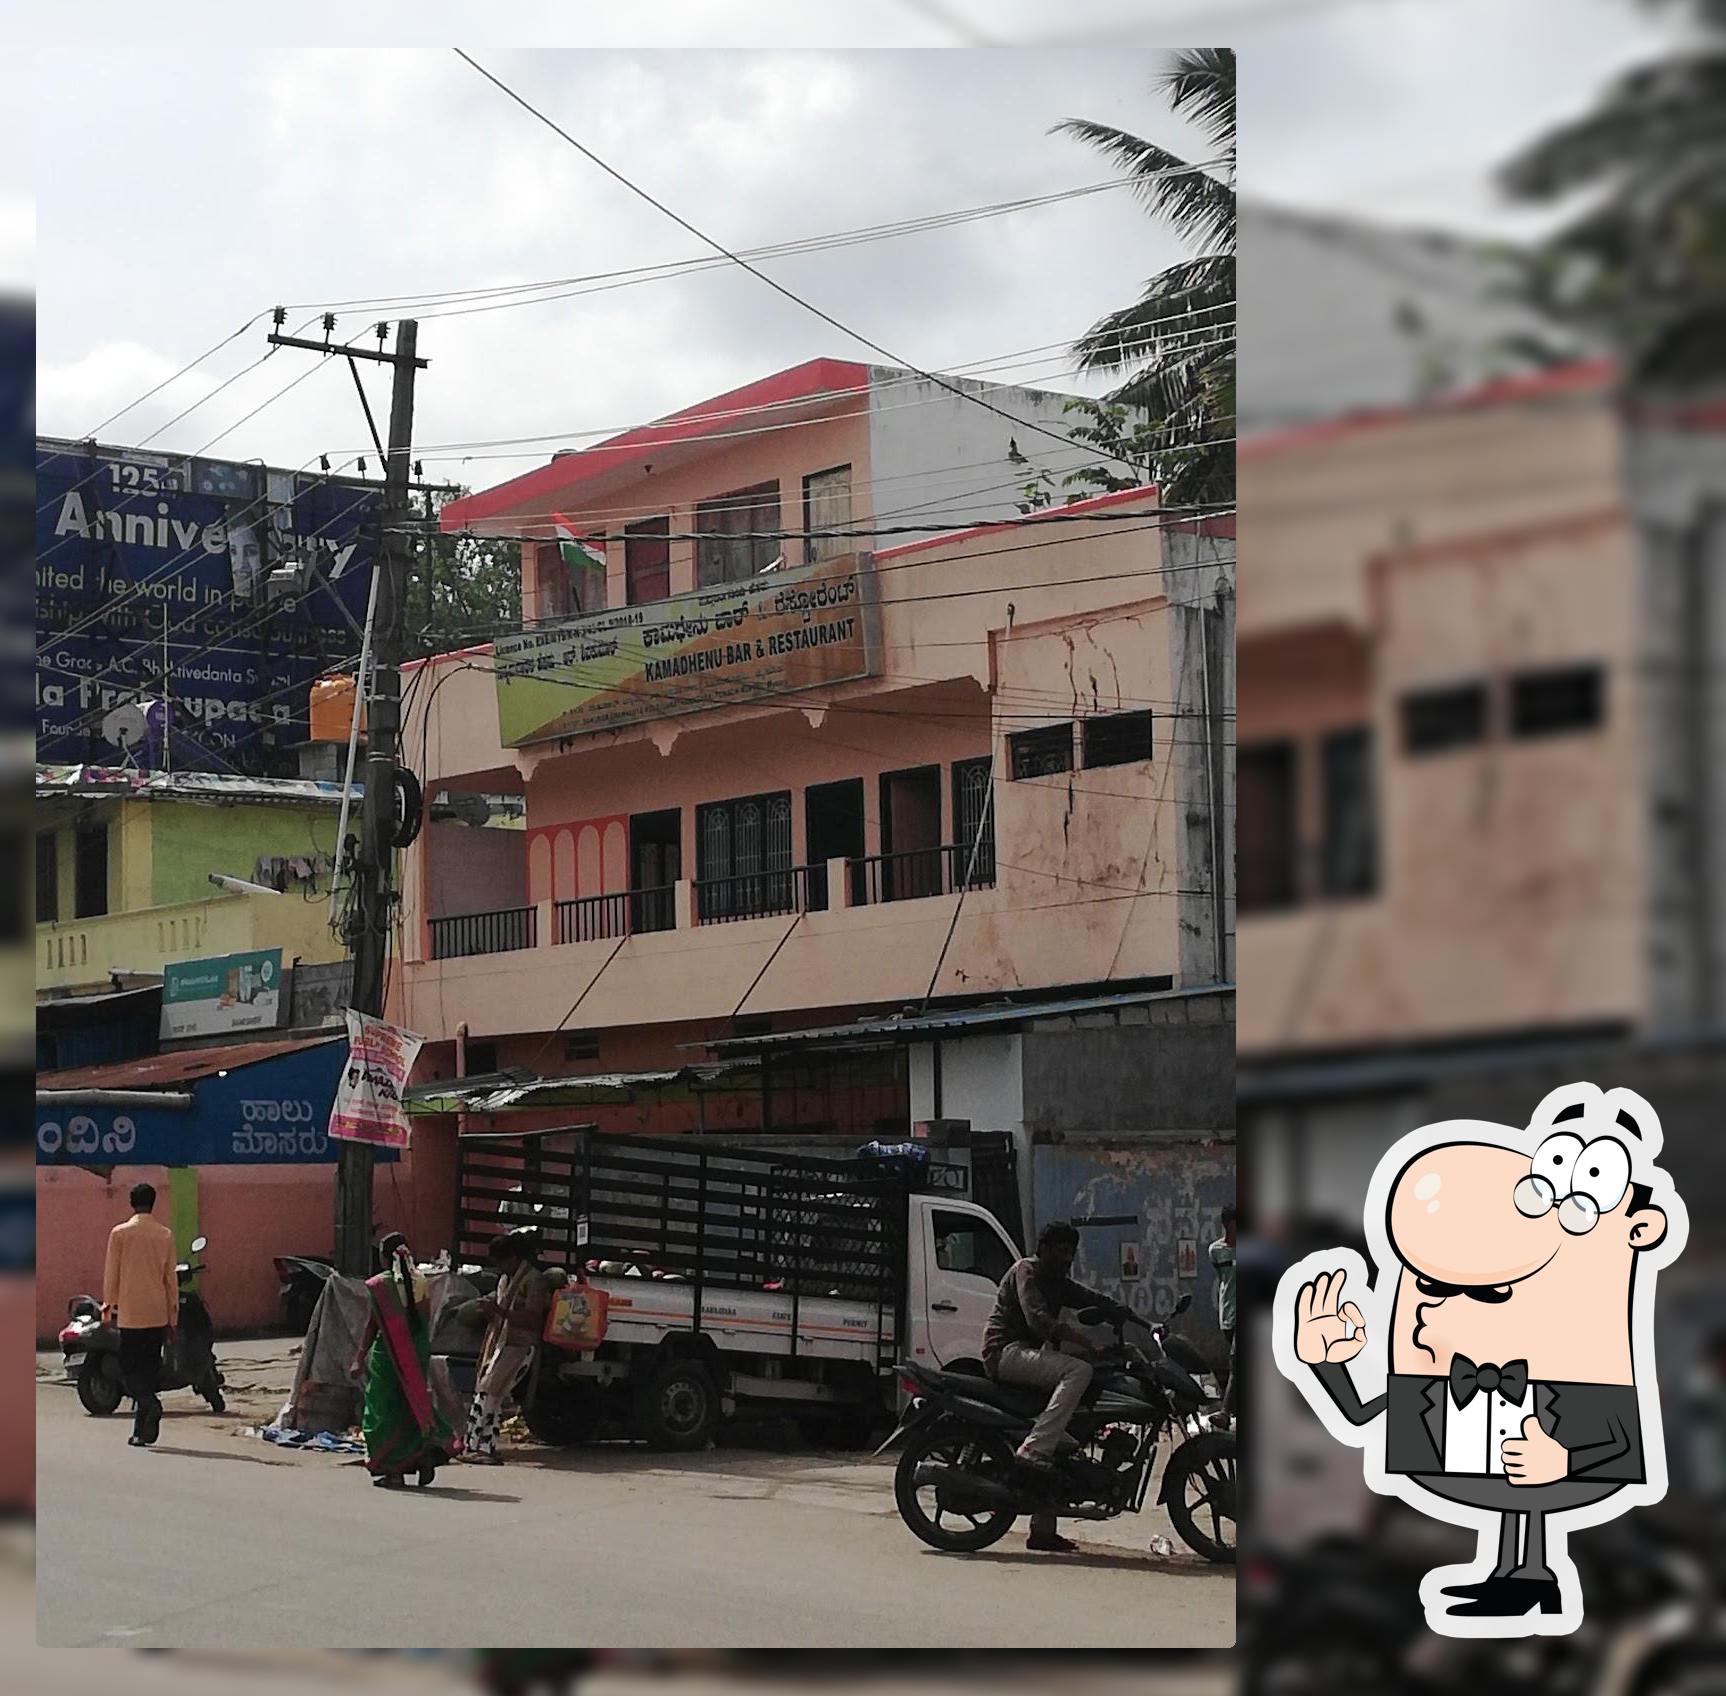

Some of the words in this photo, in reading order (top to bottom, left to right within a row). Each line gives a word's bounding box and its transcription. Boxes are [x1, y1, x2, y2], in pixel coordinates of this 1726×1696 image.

[134, 576, 197, 602] world
[204, 587, 223, 605] in
[56, 650, 103, 671] Grac
[645, 648, 722, 683] KAMADHENU
[726, 643, 752, 666] BAR
[756, 639, 765, 658] &
[769, 618, 855, 656] RESTAURANT
[240, 1098, 313, 1122] ಹಾಲು
[232, 1123, 328, 1155] ಮೊಸರು
